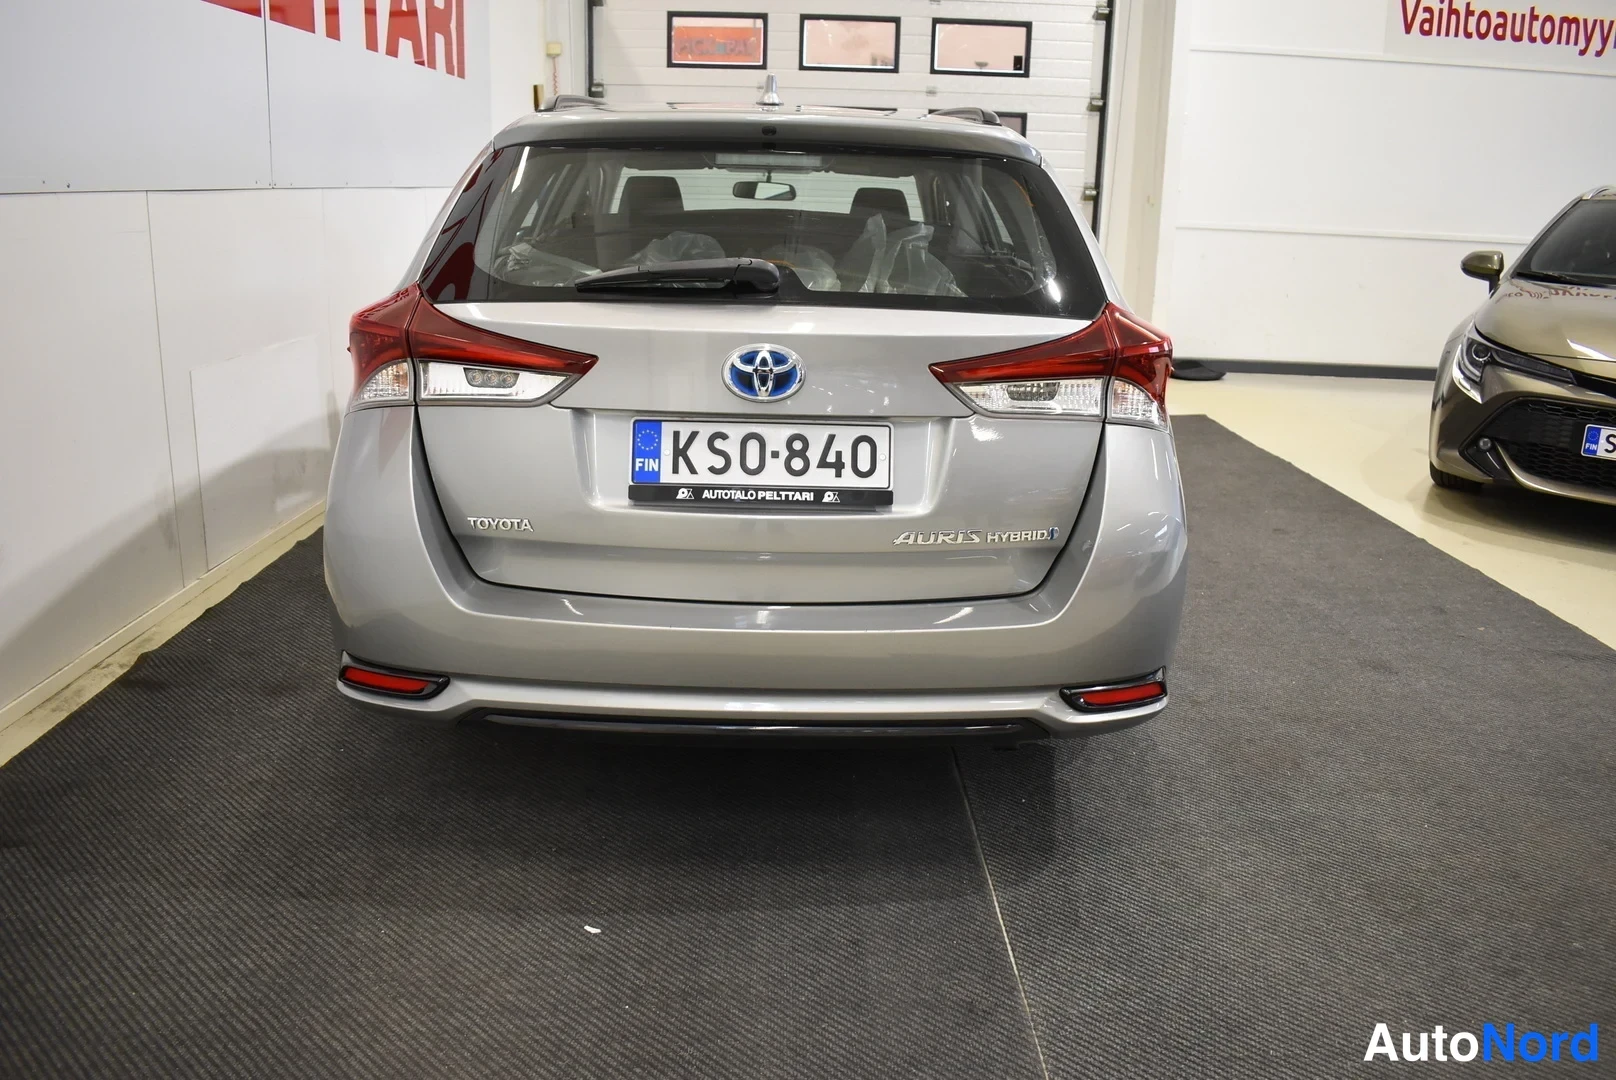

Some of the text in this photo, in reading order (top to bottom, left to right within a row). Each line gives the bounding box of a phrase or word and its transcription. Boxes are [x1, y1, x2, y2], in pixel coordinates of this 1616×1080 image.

[1401, 0, 1616, 57] Vaihtoautomyy
[671, 430, 878, 478] KSO-840
[1584, 442, 1598, 451] FIN
[635, 457, 660, 472] FIN
[702, 488, 814, 502] AUTOTALO PELTTARI
[467, 517, 534, 532] TOYOTA
[892, 529, 1052, 546] AURIS HYBRID
